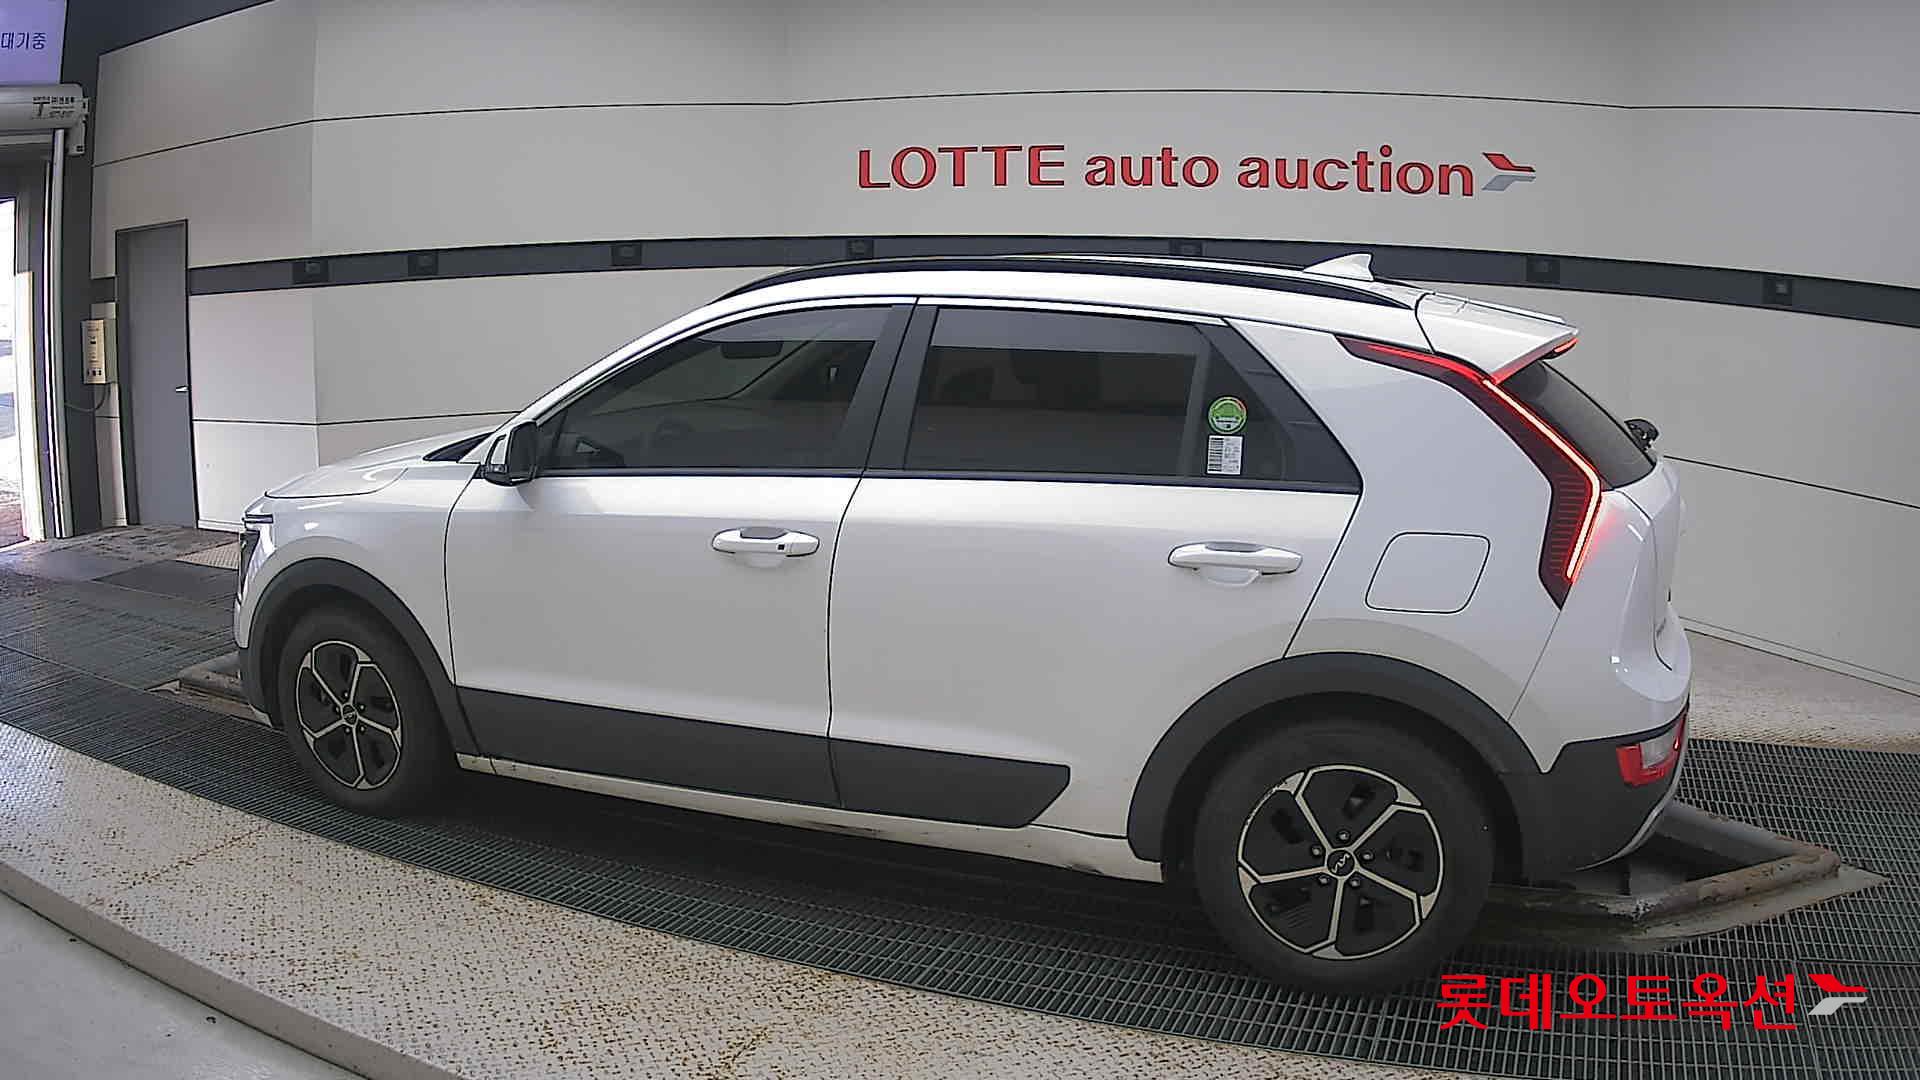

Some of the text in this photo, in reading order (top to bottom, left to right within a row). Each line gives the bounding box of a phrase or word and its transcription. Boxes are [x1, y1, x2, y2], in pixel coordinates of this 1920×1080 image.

[1, 32, 46, 49] 대기중
[857, 144, 1475, 197] LOTTE auto auction
